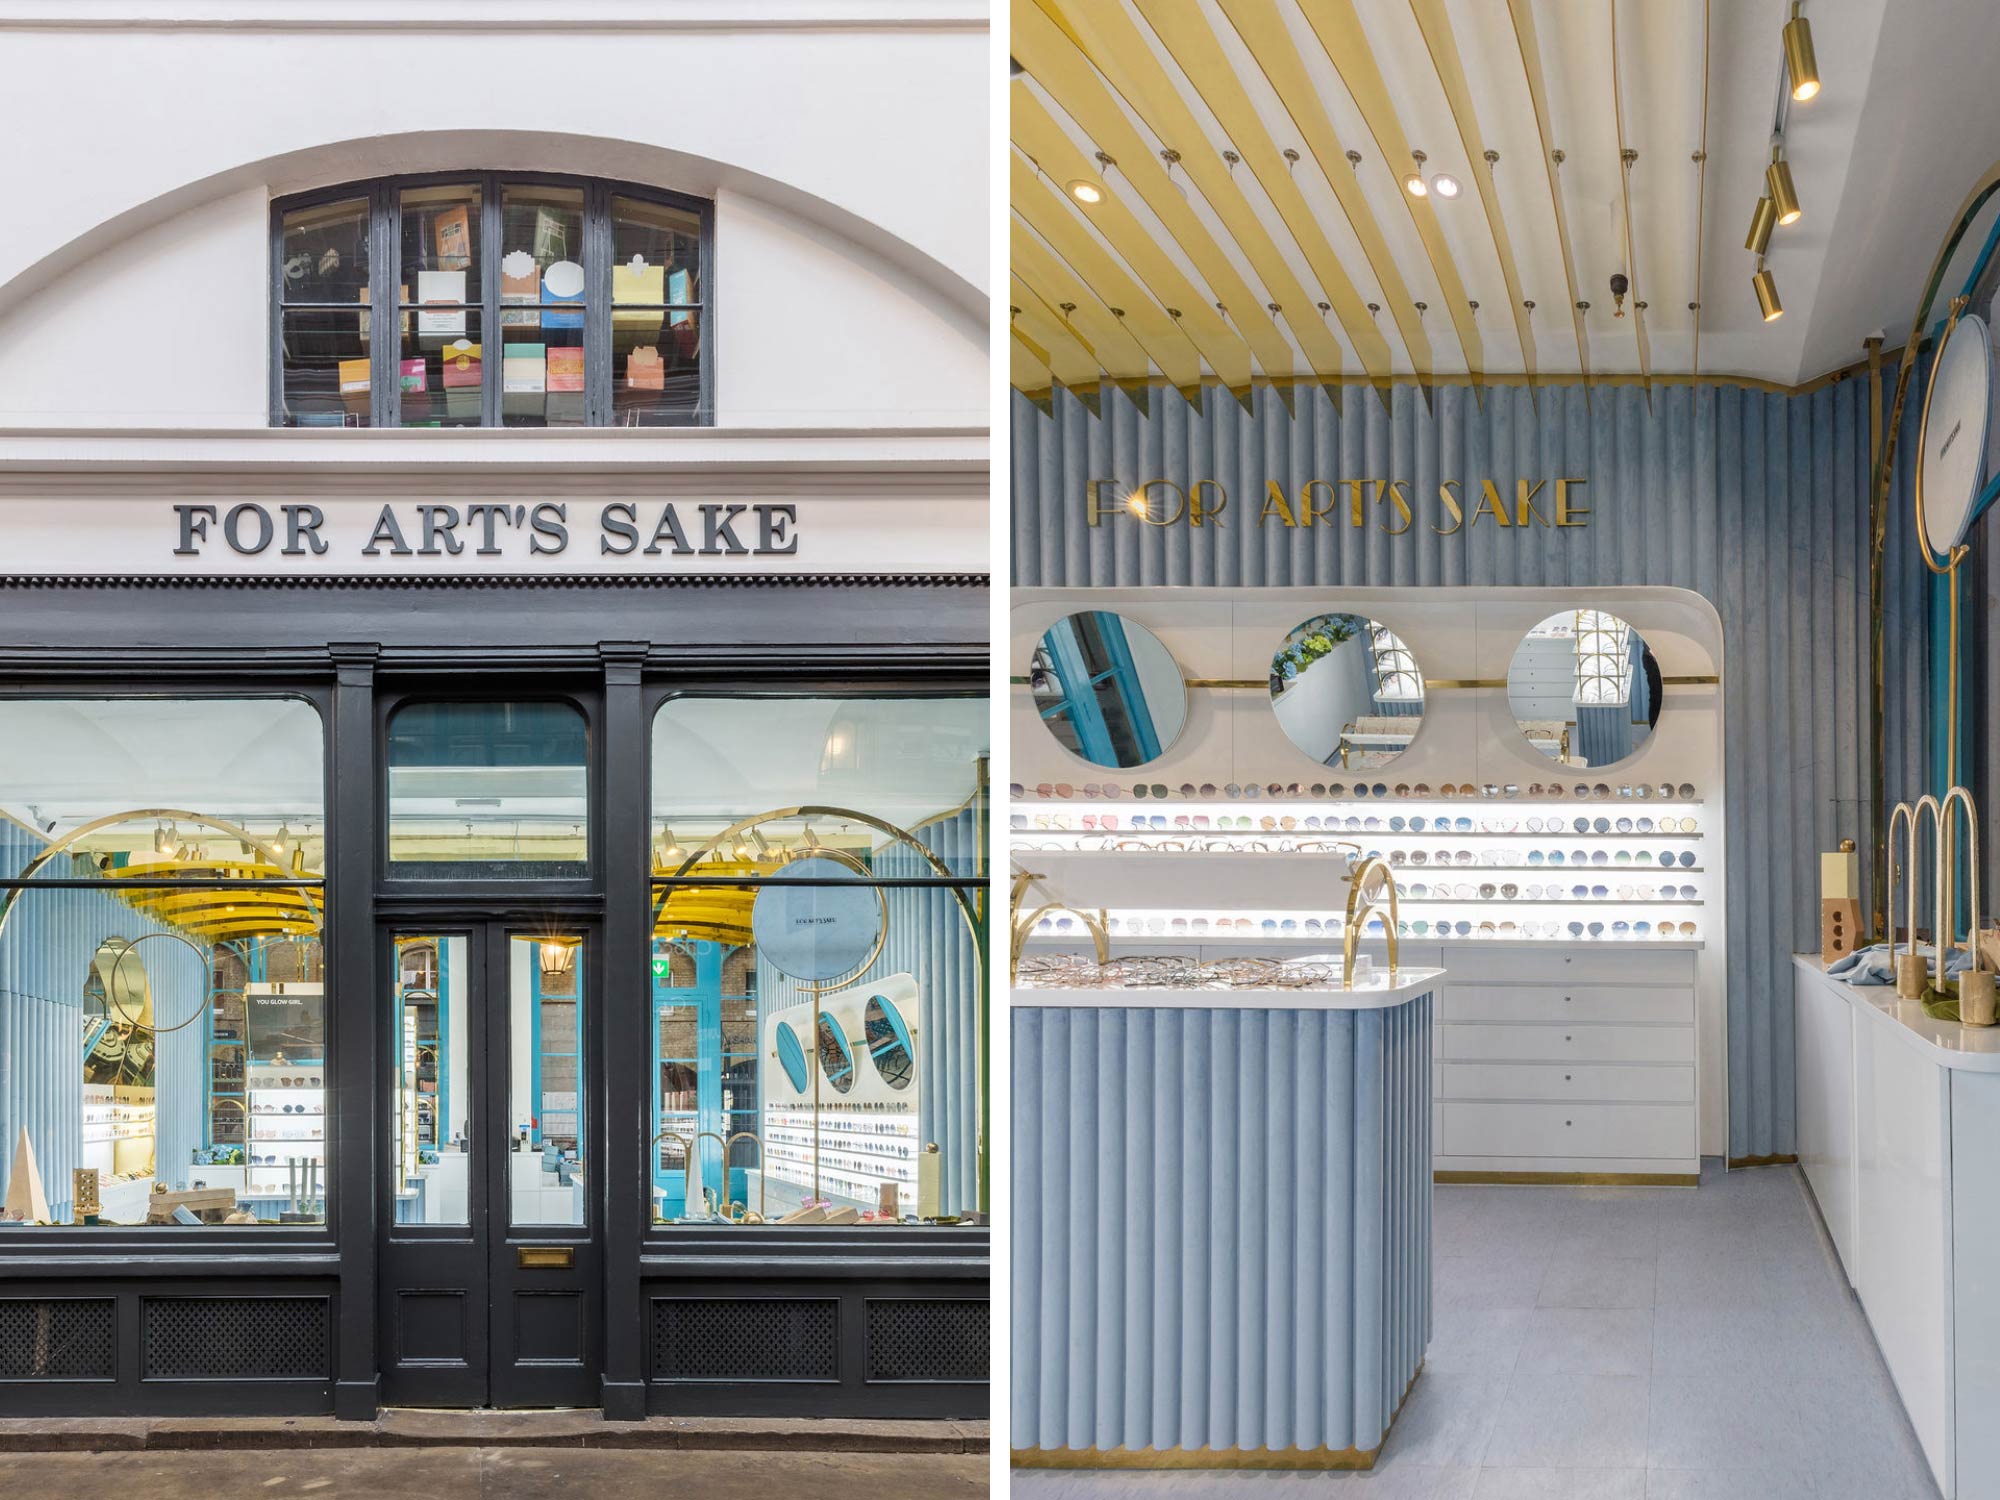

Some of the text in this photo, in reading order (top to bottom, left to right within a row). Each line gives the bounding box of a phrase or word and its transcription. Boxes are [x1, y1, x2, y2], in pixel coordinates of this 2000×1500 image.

[172, 502, 799, 556] FOR ART'S SAKE
[1086, 478, 1592, 536] FOR ART'S SAKE
